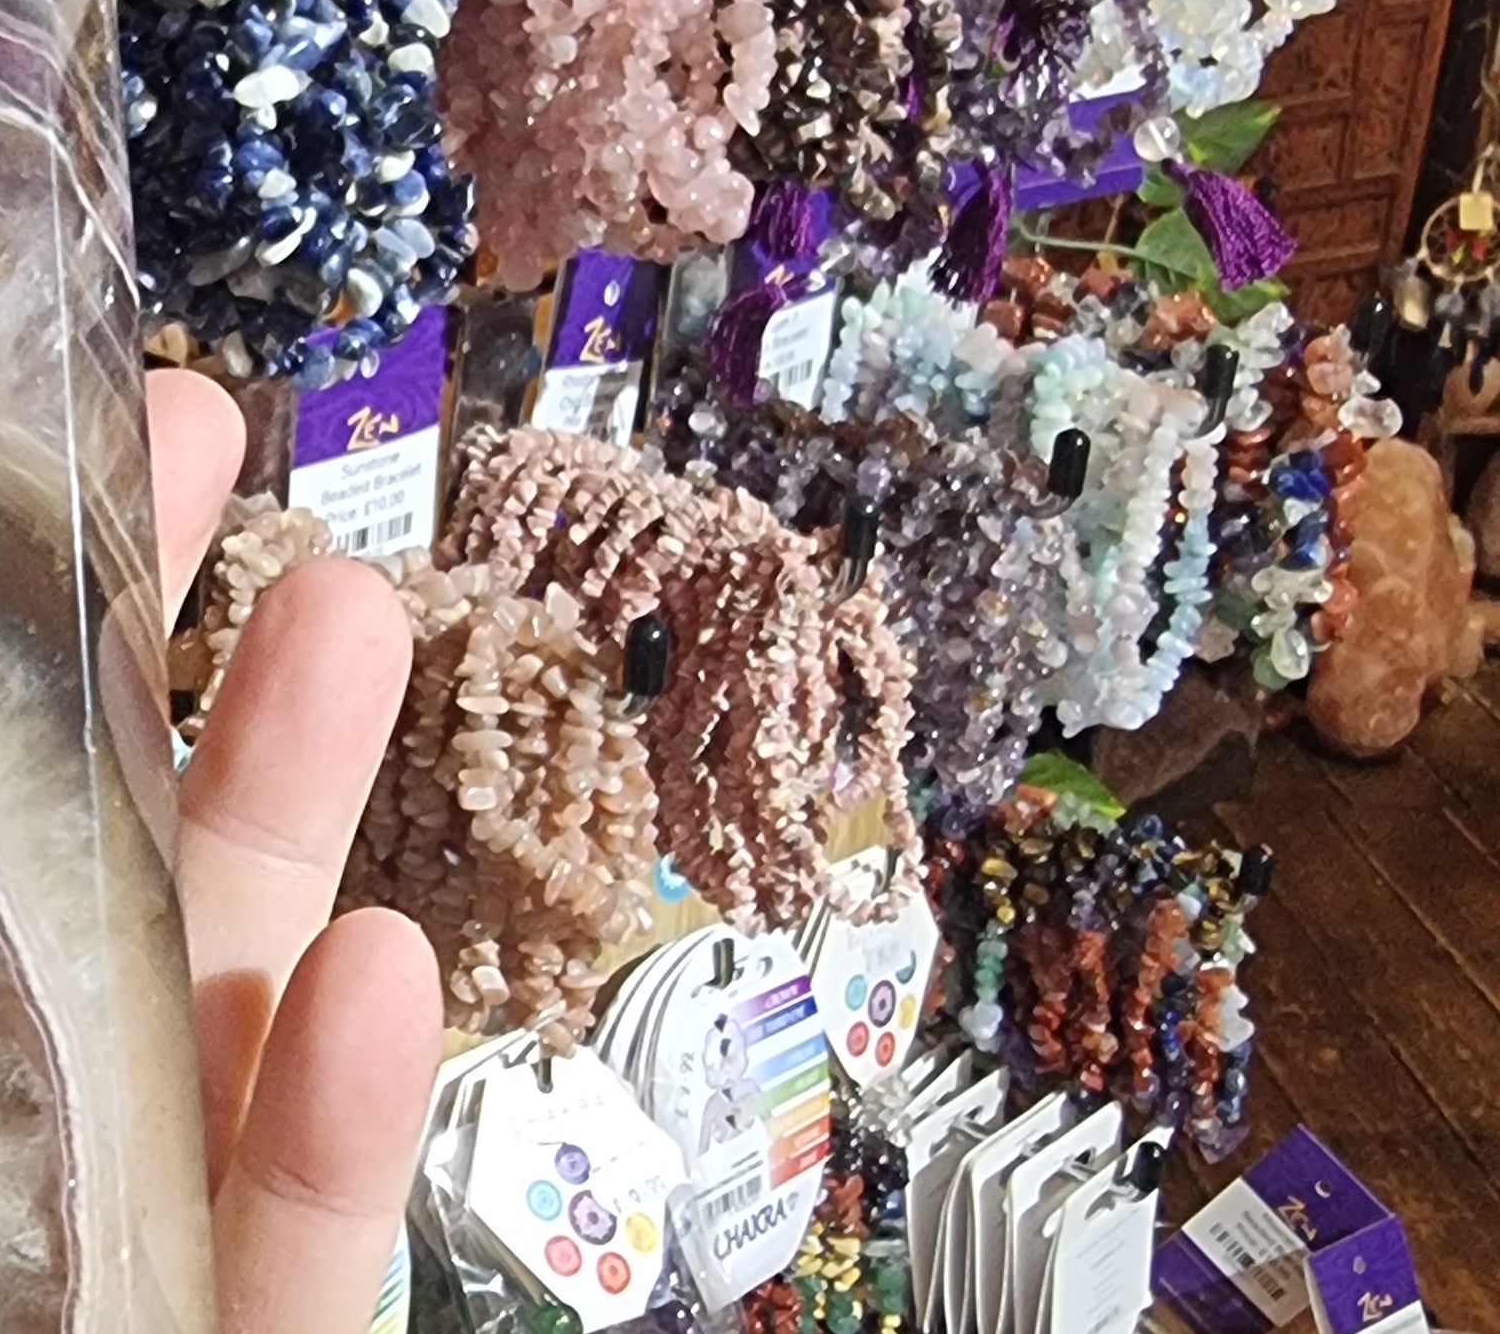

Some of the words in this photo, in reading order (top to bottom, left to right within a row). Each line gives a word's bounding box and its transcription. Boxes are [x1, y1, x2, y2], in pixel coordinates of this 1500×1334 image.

[579, 316, 621, 363] ZEN
[347, 406, 399, 451] ZEN
[1277, 1195, 1317, 1241] ZEN
[1357, 1291, 1394, 1323] ZEN
